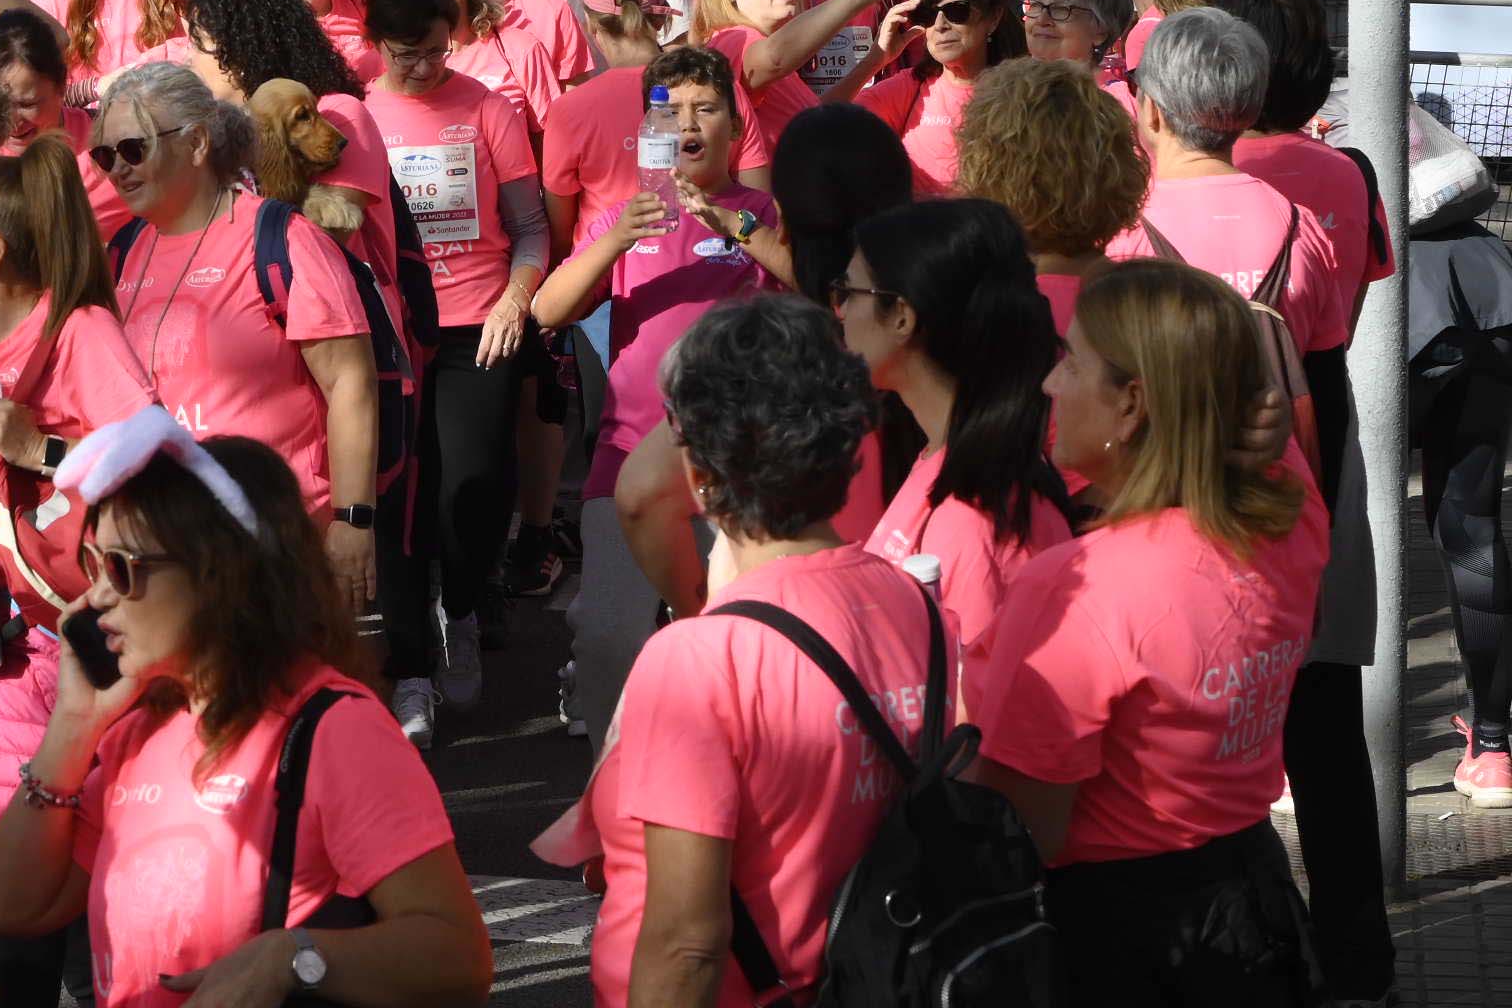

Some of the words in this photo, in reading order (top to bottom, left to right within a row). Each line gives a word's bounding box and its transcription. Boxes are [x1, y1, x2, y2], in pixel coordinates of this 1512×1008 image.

[820, 55, 847, 67] 016
[436, 225, 472, 235] Santander
[1203, 632, 1305, 700] CARRERA
